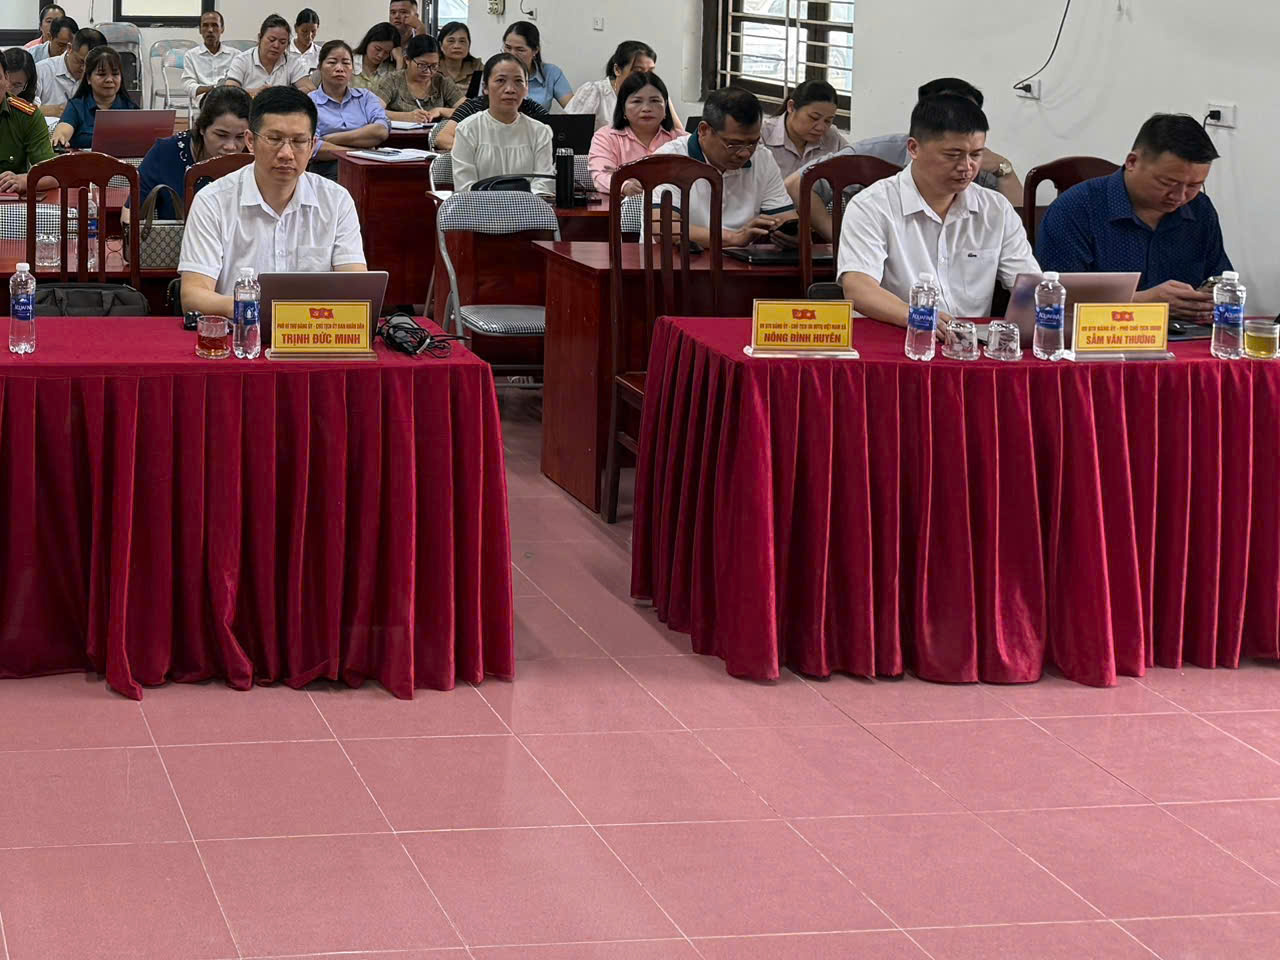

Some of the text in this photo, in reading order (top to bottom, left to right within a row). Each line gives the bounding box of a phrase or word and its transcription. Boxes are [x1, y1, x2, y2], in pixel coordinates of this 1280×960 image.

[282, 331, 360, 346] TRỊNH ĐỨC MINH
